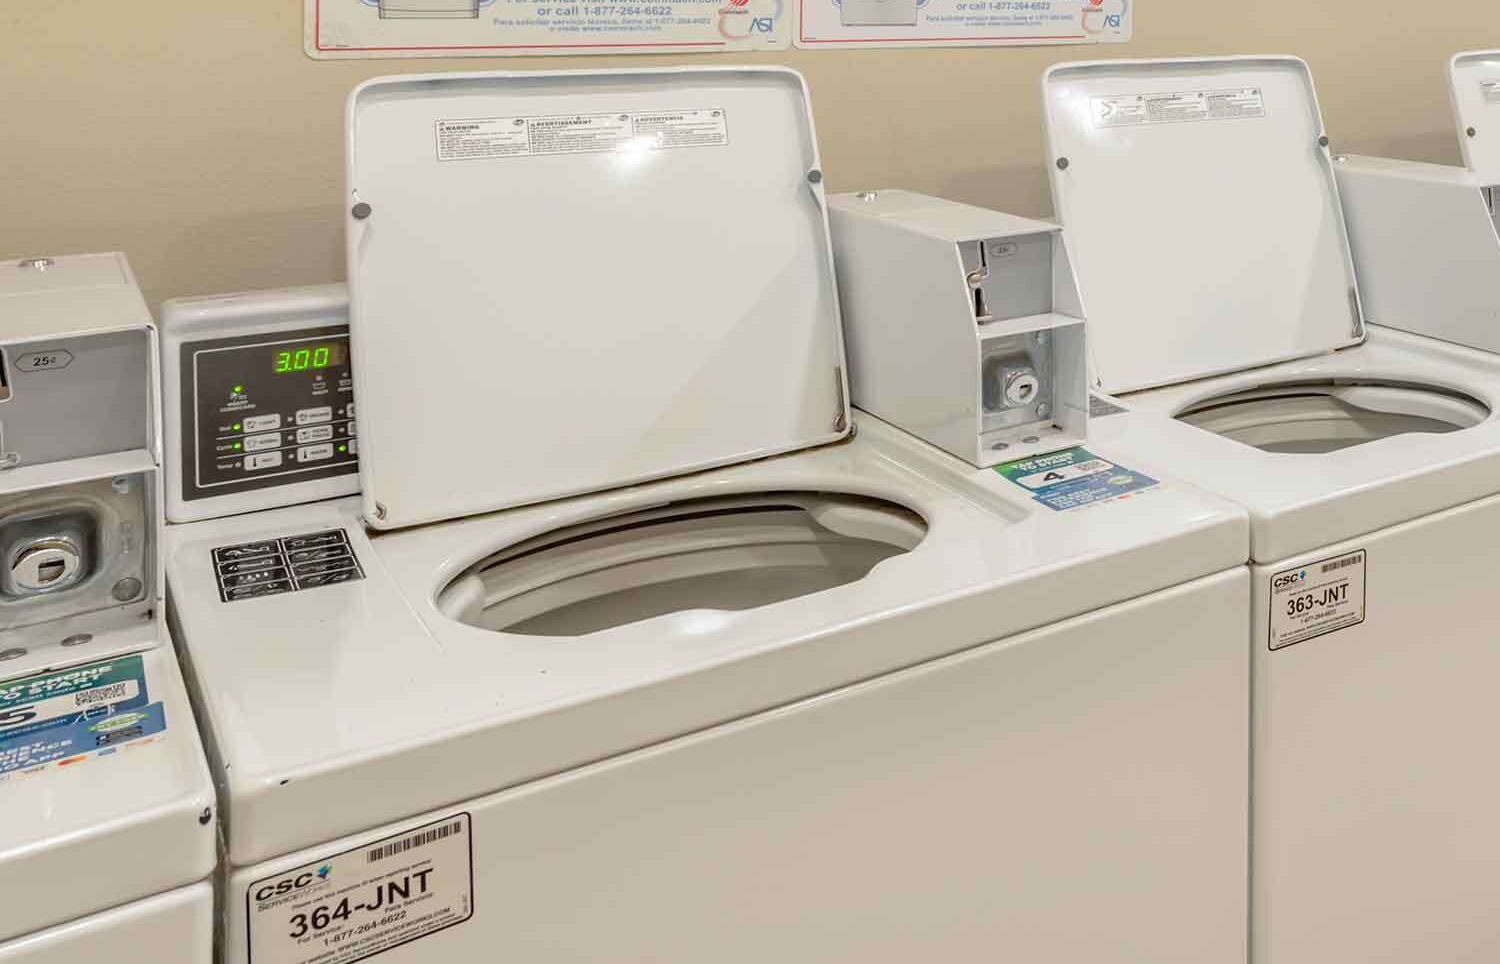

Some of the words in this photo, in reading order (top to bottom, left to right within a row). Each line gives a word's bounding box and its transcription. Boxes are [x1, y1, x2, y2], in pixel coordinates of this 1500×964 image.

[537, 7, 553, 17] or
[555, 6, 580, 17] call
[583, 5, 673, 17] 1-877-264-6622
[969, 2, 986, 10] call
[445, 124, 480, 132] WARNING
[274, 347, 330, 373] 3.00
[1273, 572, 1299, 588] CSC
[1286, 582, 1350, 616] 363-JNT
[0, 705, 37, 726] 5
[255, 872, 313, 902] CSC
[288, 867, 434, 939] 364-JNT
[385, 902, 401, 914] Para
[323, 910, 408, 947] 1-877-264-6622
